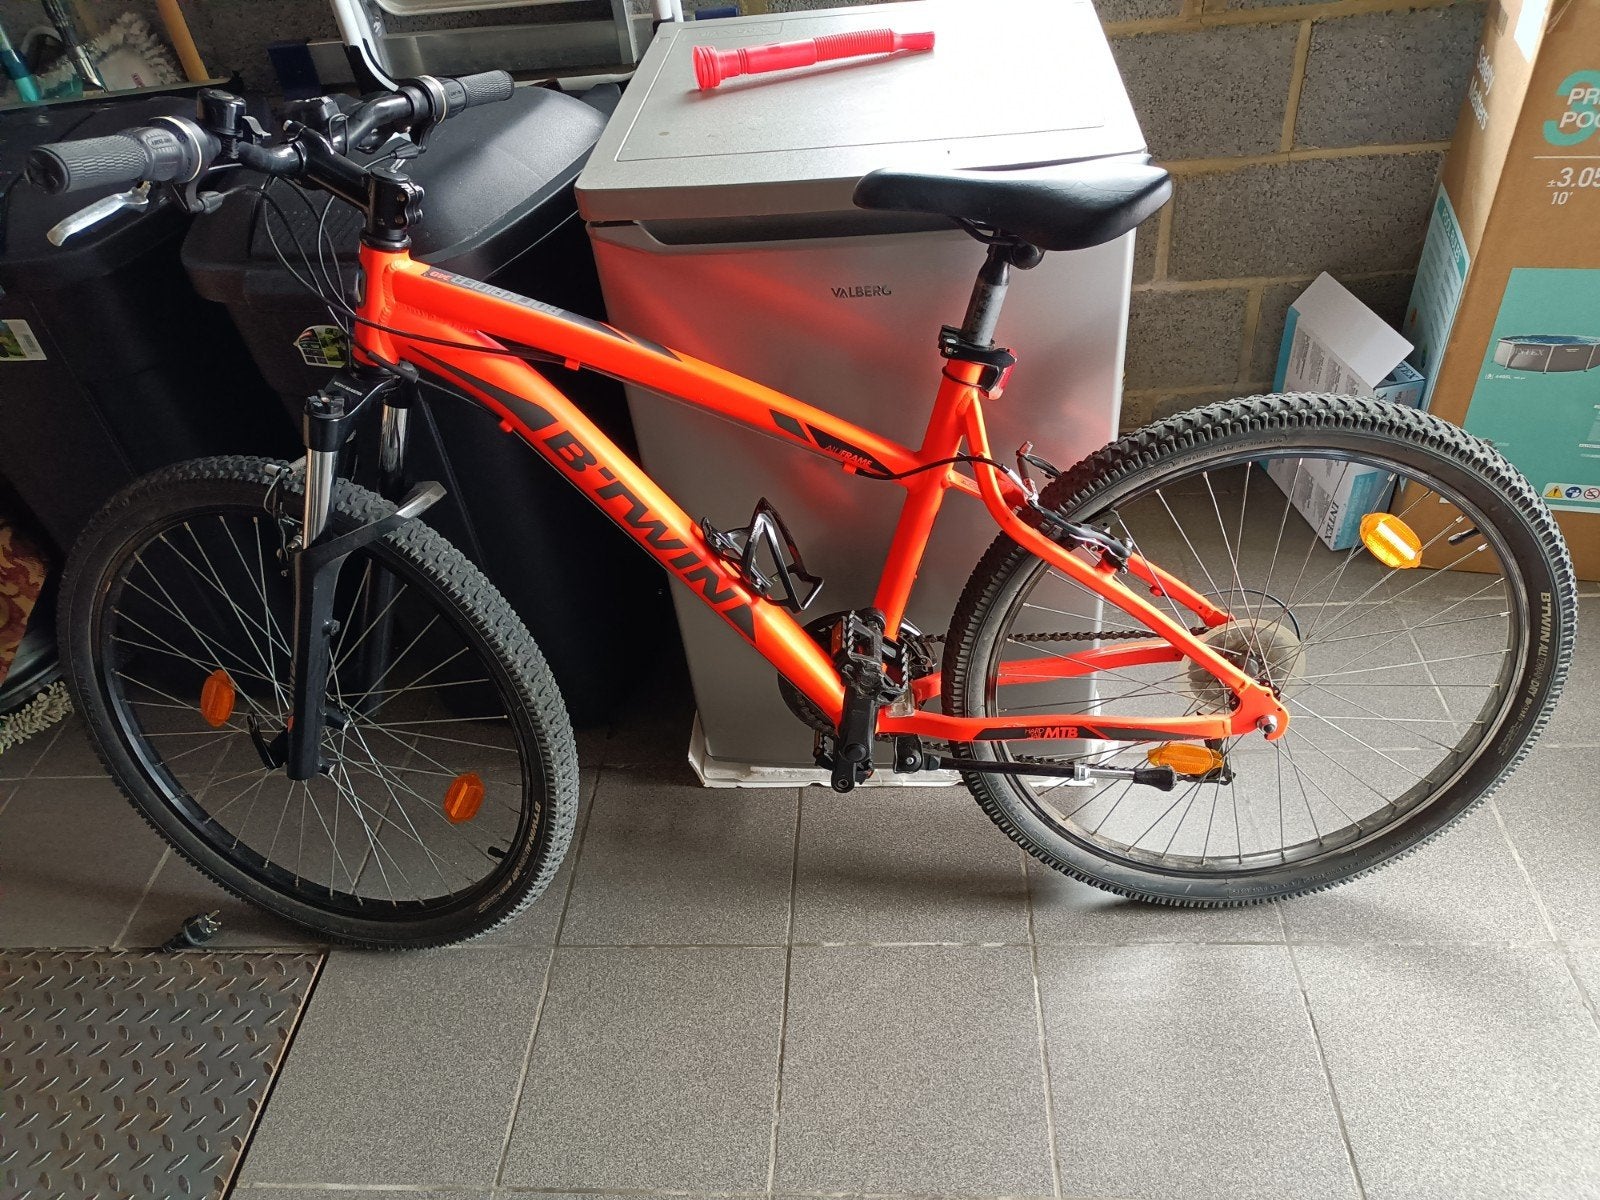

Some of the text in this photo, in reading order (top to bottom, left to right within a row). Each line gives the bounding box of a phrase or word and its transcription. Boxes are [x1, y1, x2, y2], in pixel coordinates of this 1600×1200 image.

[1567, 88, 1600, 105] PR
[831, 285, 892, 298] VALBERG
[543, 430, 738, 604] B'TWIN
[1324, 502, 1340, 541] INTEX
[1044, 727, 1079, 740] MTB
